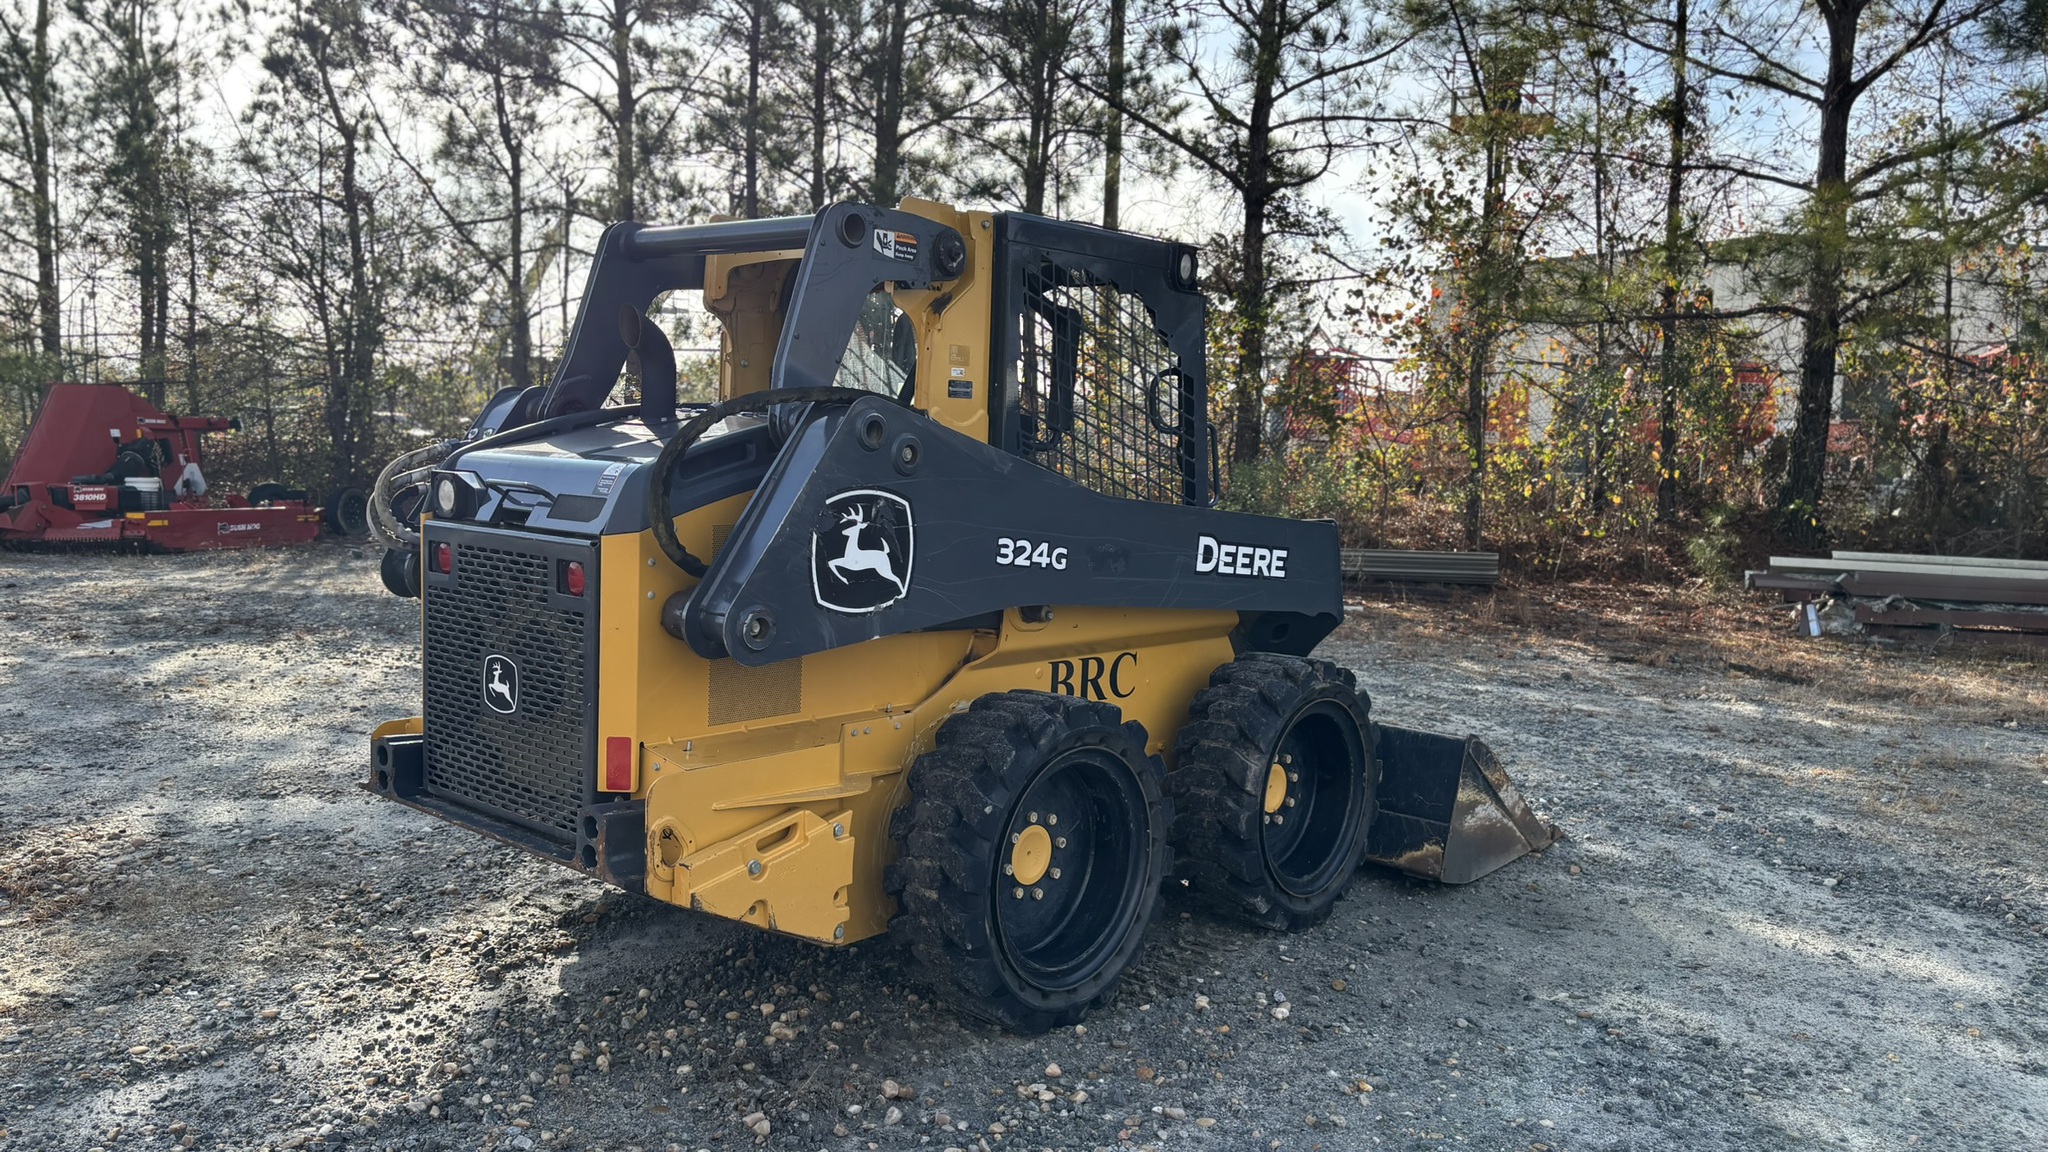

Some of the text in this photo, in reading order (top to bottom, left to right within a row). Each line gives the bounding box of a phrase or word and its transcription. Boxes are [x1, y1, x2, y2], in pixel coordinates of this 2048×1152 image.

[73, 493, 107, 501] 3810HD
[996, 538, 1068, 570] 324G
[1196, 536, 1288, 578] DEERE
[1048, 651, 1138, 701] BRC
